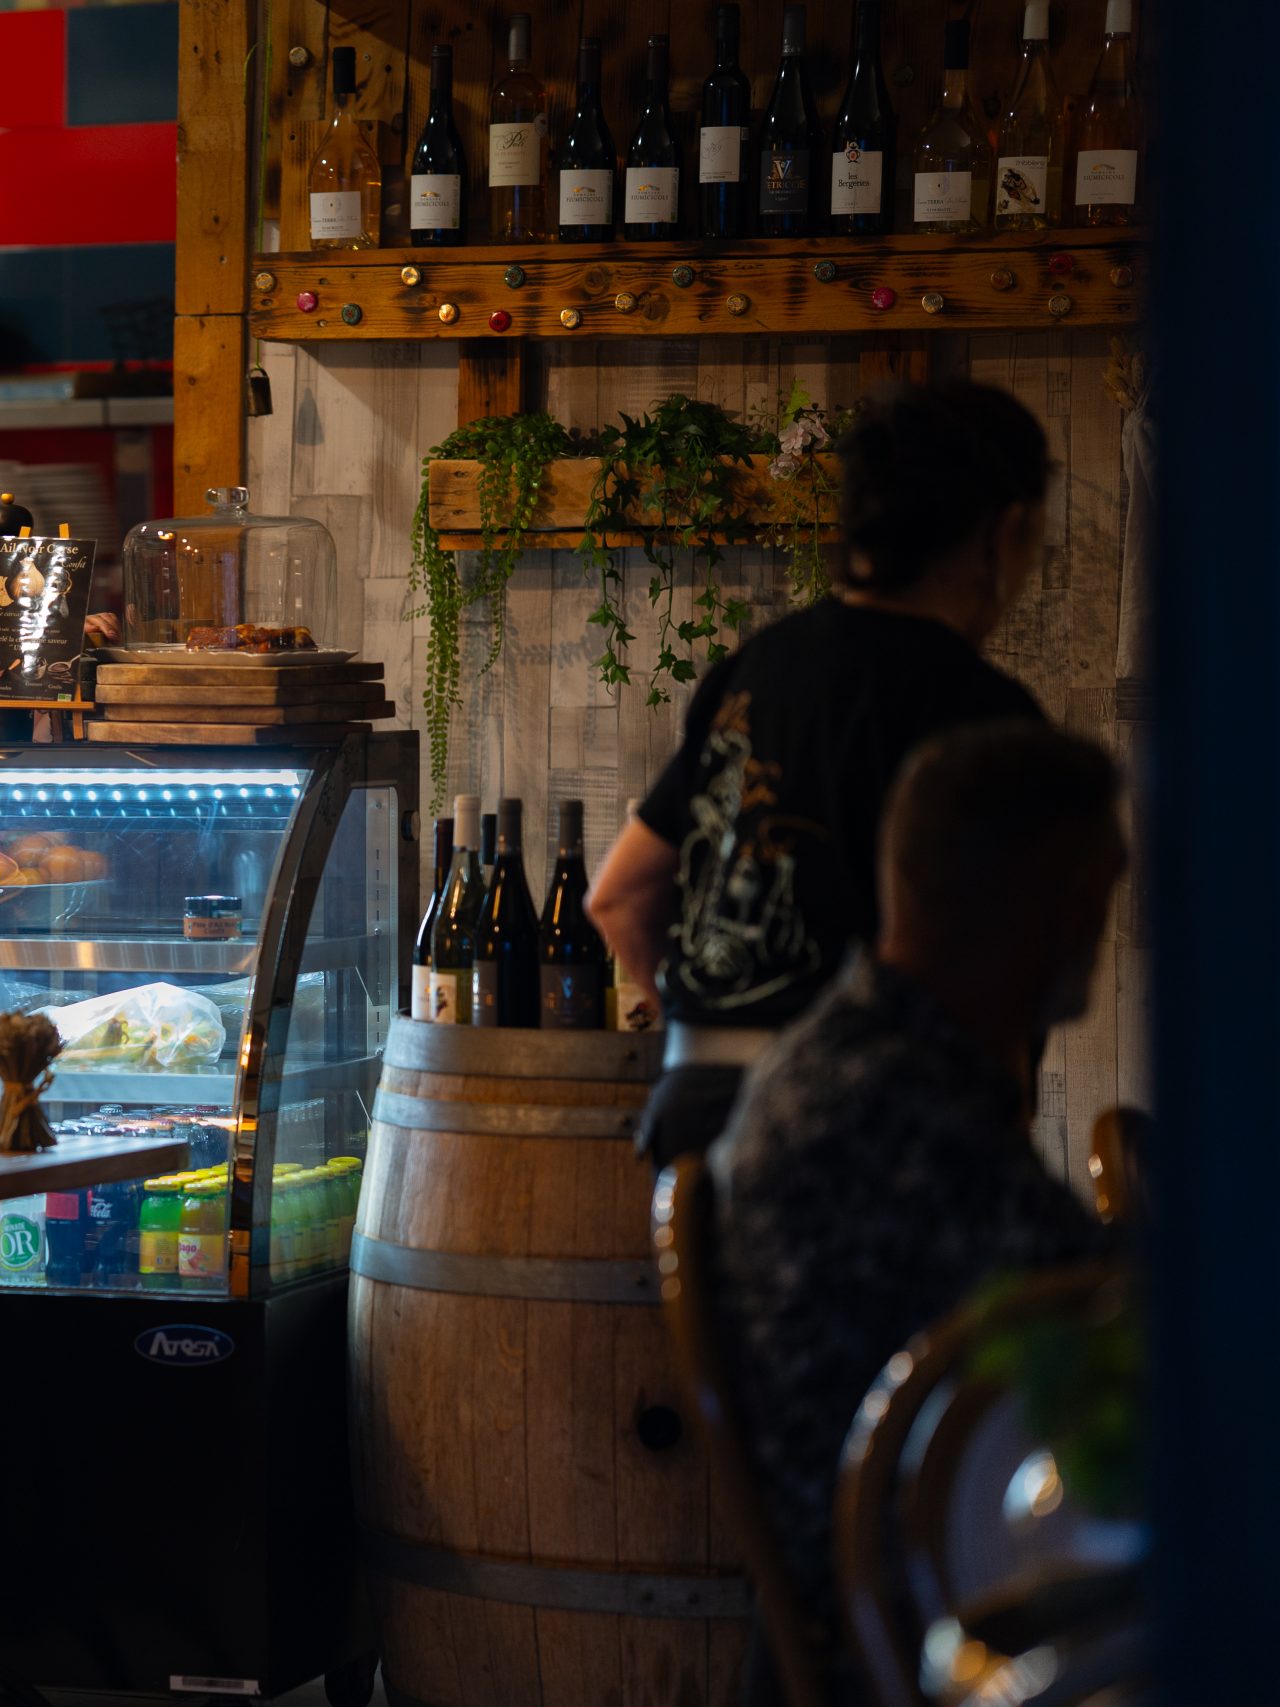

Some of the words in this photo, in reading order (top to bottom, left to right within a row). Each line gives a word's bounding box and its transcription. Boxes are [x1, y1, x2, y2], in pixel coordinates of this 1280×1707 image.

[848, 172, 858, 180] les
[838, 179, 870, 190] Bergeries
[0, 542, 17, 553] Ail
[61, 556, 87, 572] Confit
